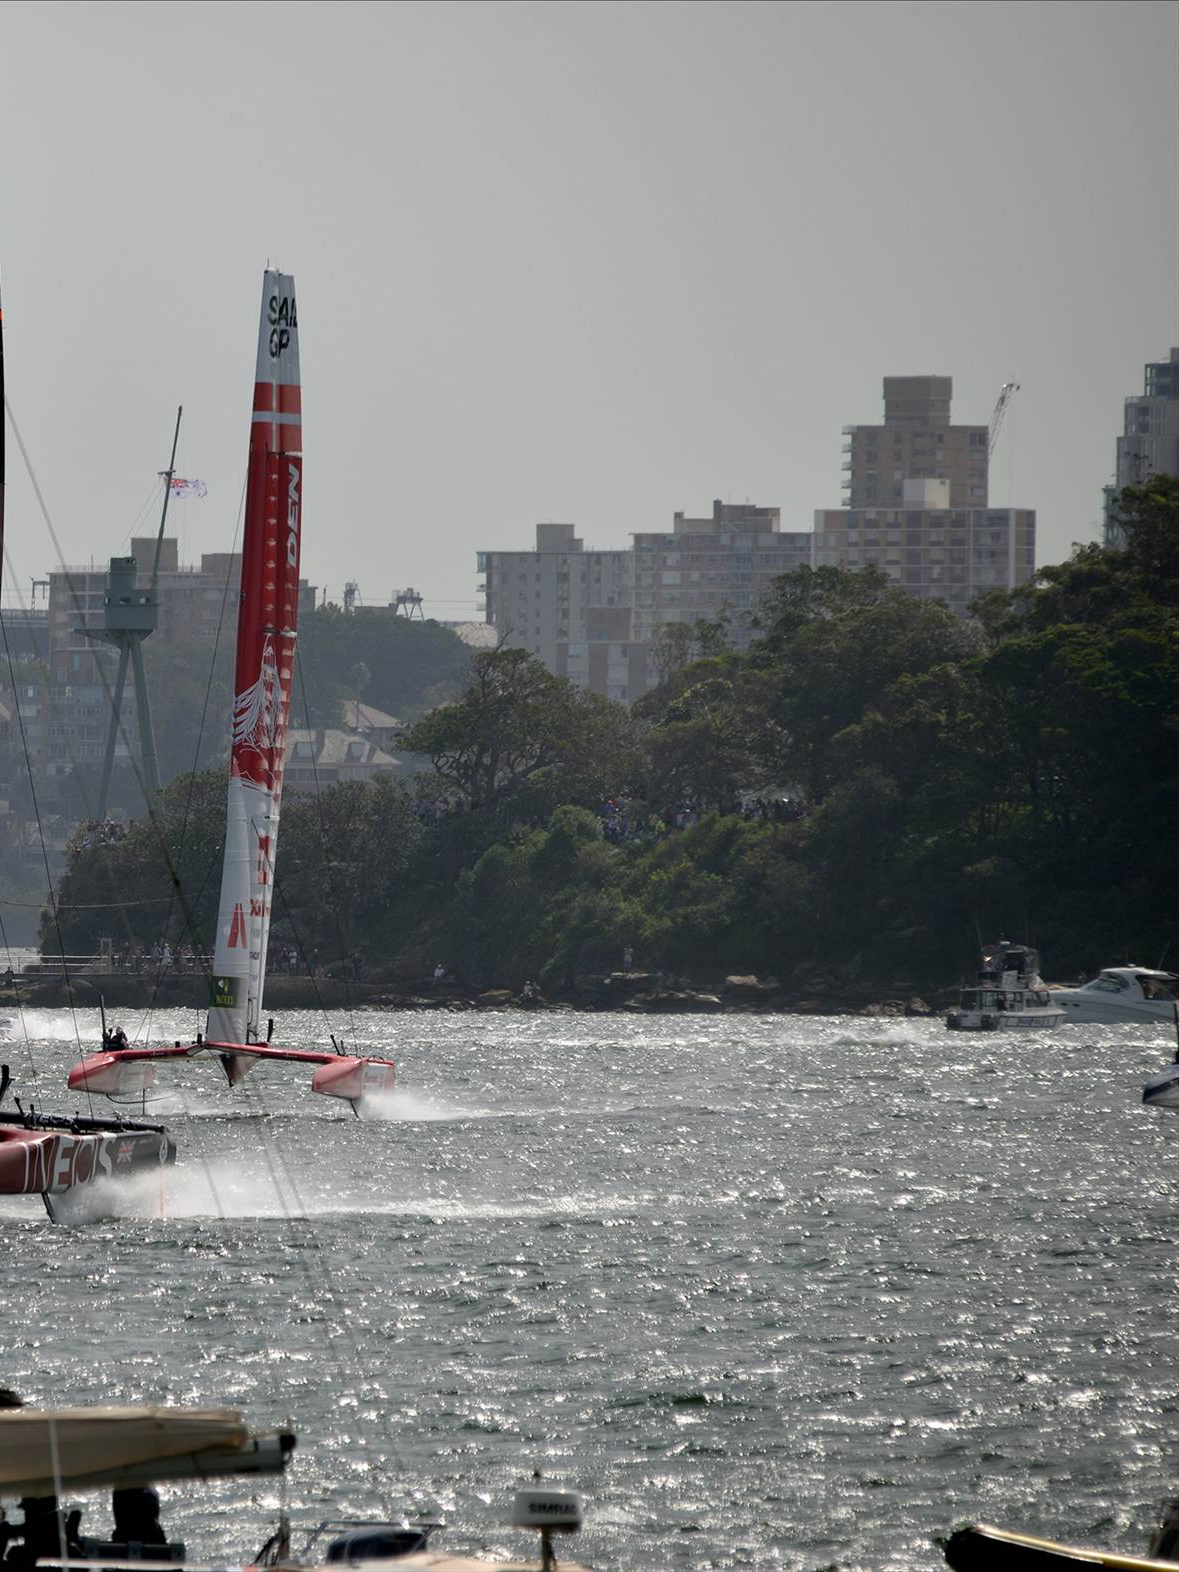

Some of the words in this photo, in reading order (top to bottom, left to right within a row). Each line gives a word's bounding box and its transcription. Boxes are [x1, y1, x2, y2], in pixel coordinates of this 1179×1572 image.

[268, 296, 297, 328] SAIL
[269, 328, 290, 358] GP
[286, 463, 300, 569] DEN
[20, 1131, 117, 1193] INEOS
